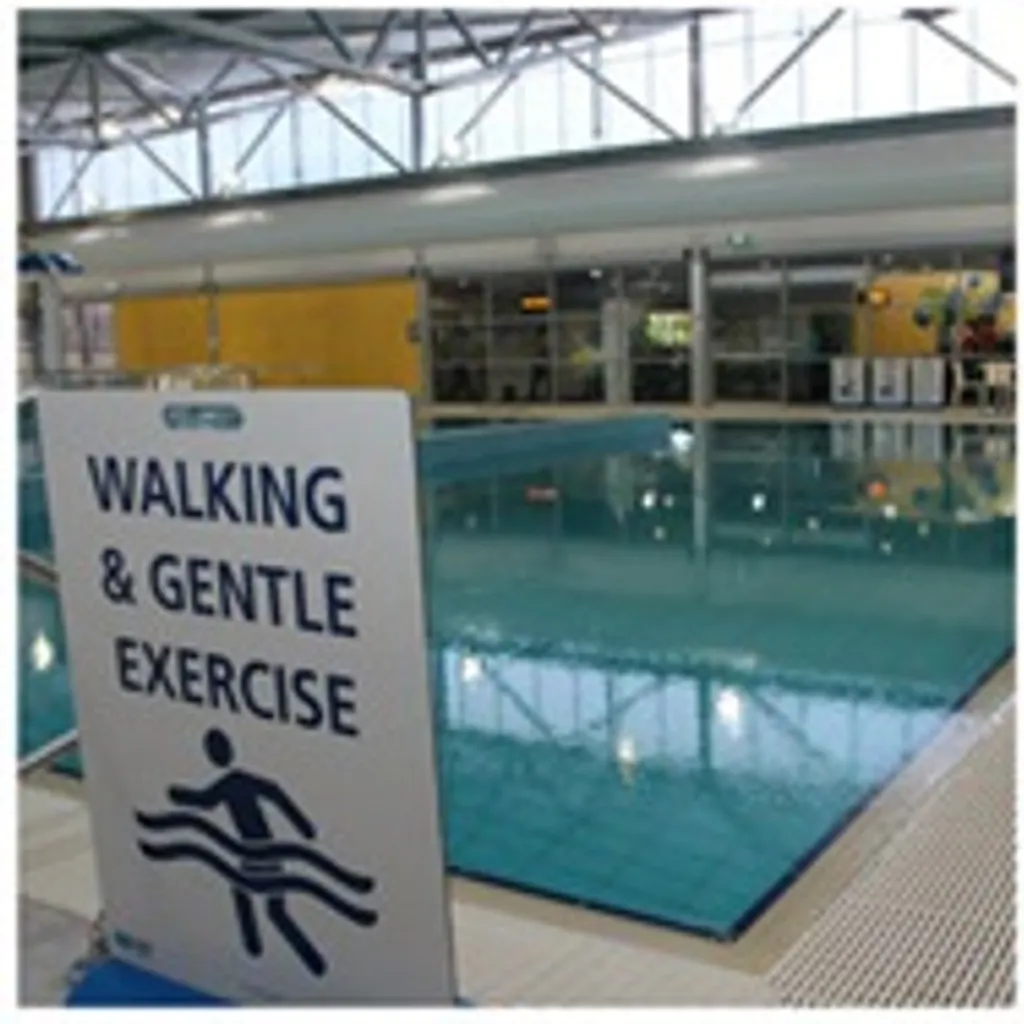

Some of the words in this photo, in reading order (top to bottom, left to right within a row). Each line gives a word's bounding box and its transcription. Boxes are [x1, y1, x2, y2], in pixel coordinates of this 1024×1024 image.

[86, 454, 348, 534] WALKING
[100, 546, 137, 605] &
[148, 553, 358, 638] GENTLE
[115, 637, 360, 737] EXERCISE
